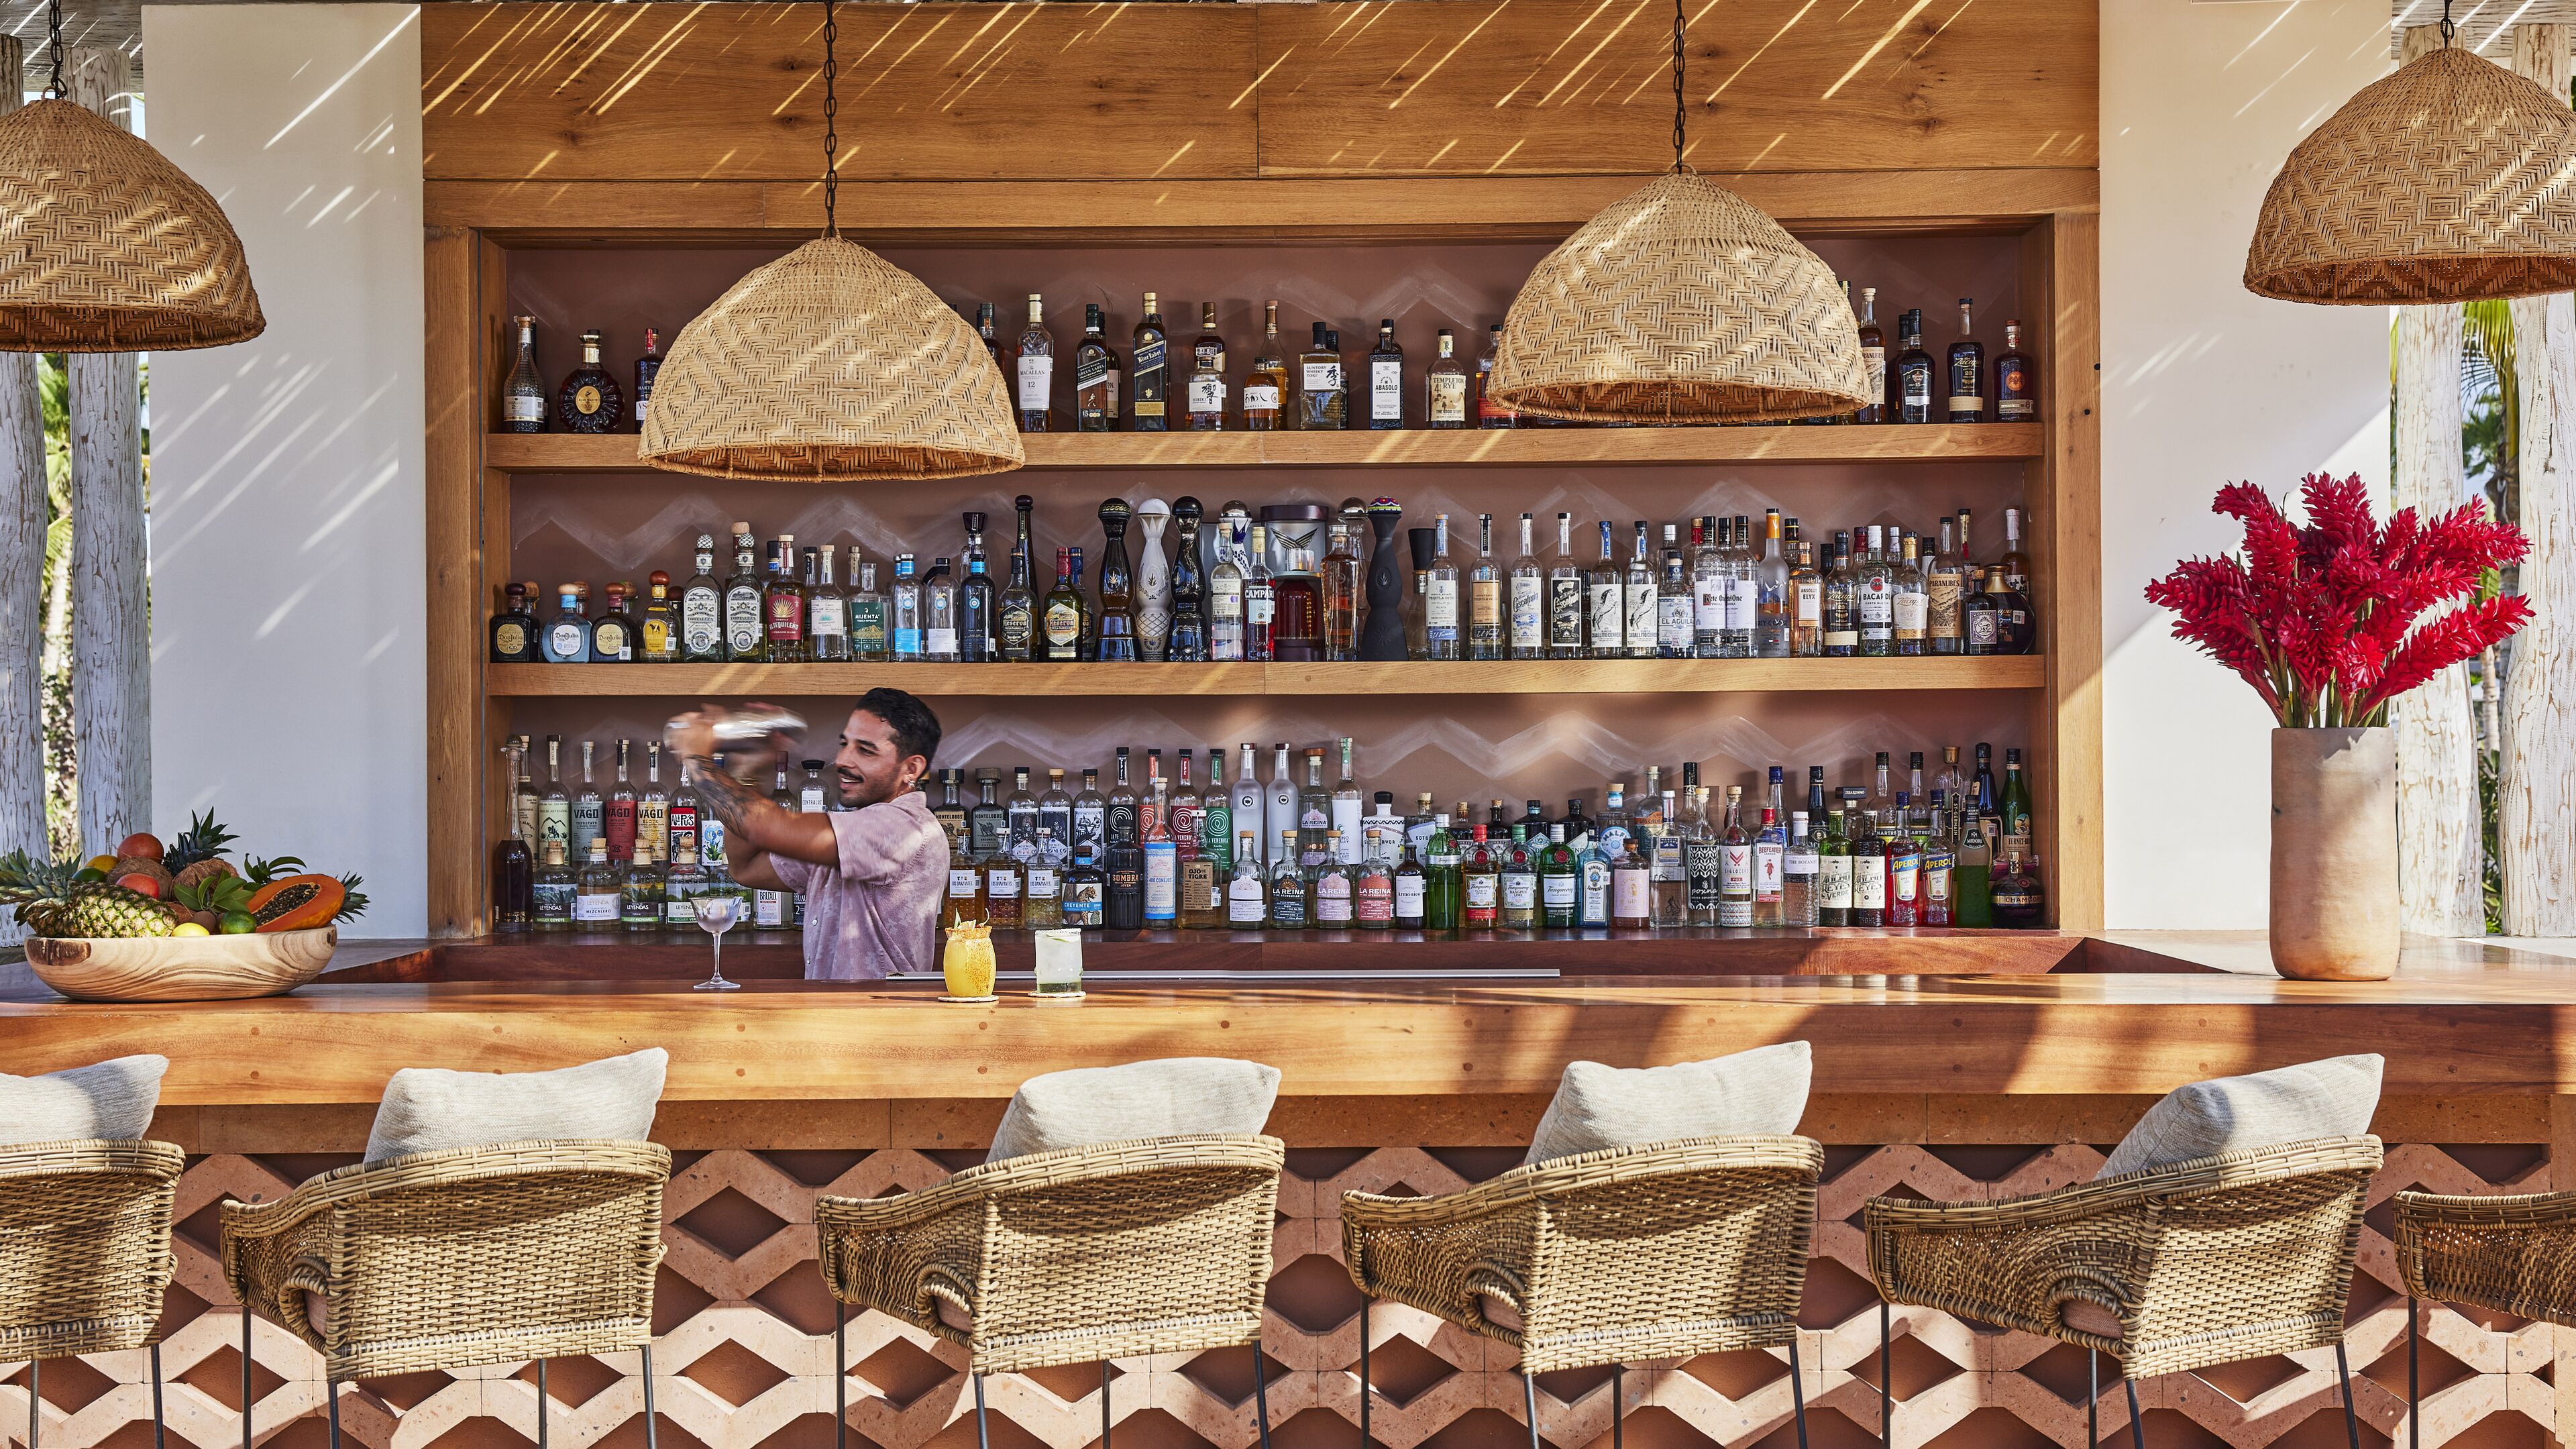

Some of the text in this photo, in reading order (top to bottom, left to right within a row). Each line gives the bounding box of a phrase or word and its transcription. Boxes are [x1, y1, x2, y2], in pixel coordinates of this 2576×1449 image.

[1137, 350, 1161, 364] Blue Label
[1245, 590, 1274, 598] CAMPARI
[1892, 857, 1919, 870] APEROL
[1925, 858, 1951, 871] APEROL
[760, 892, 777, 900] BRUXO
[1827, 891, 1849, 900] VERDE
[796, 906, 800, 914] 2
